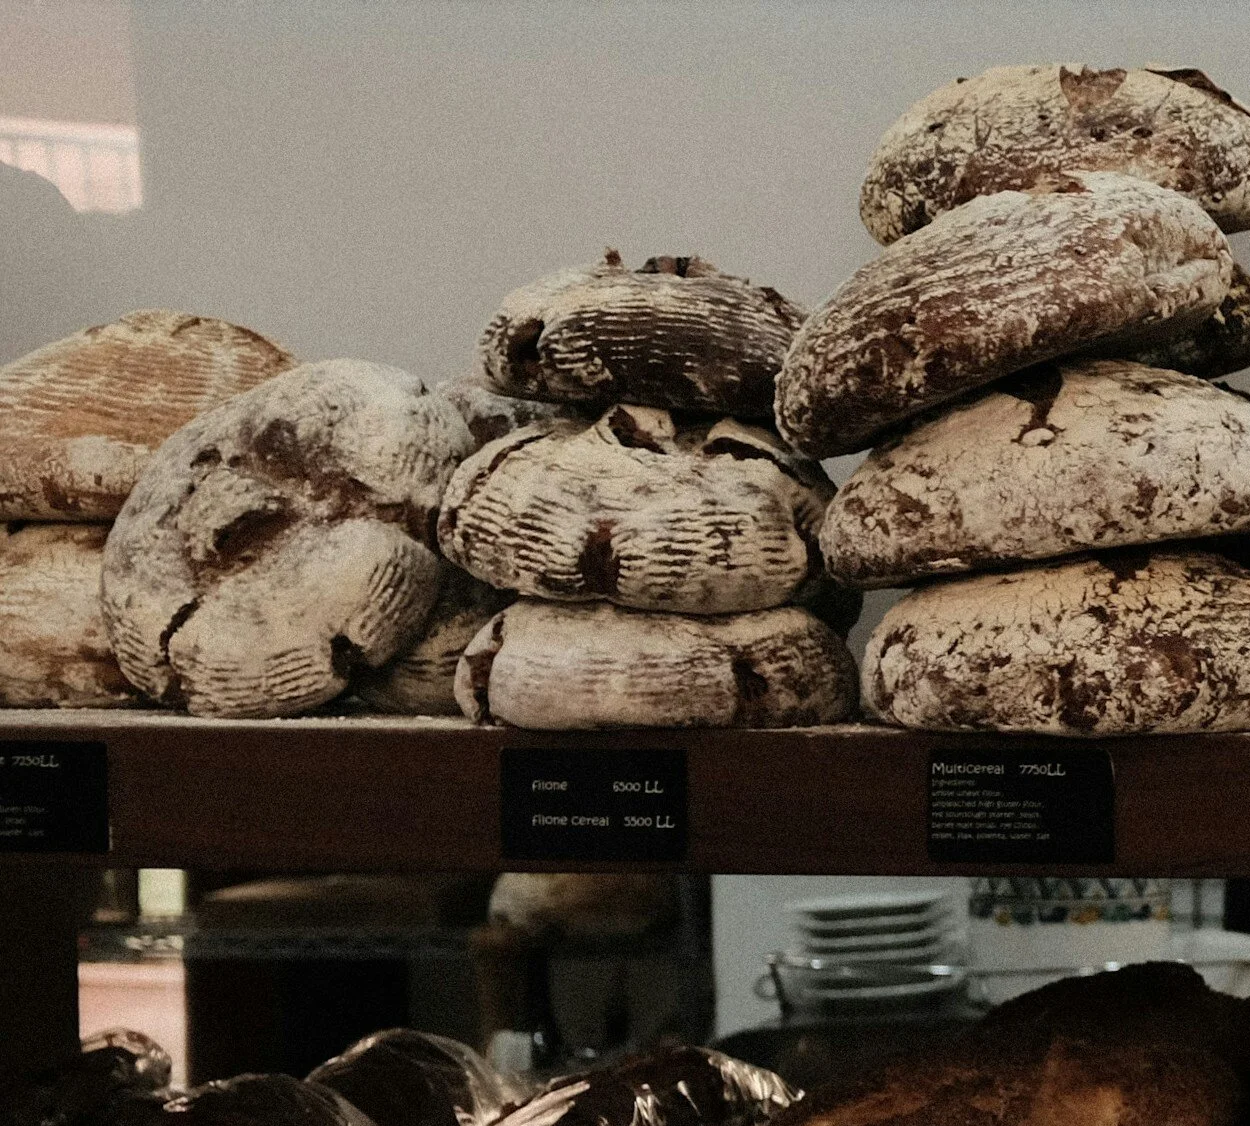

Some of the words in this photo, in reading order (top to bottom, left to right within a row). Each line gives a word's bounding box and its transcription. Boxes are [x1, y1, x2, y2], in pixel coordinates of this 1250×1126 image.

[1019, 762, 1067, 777] 7750LL
[612, 780, 642, 793] 6500
[645, 780, 664, 794] LL
[656, 815, 675, 829] LL
